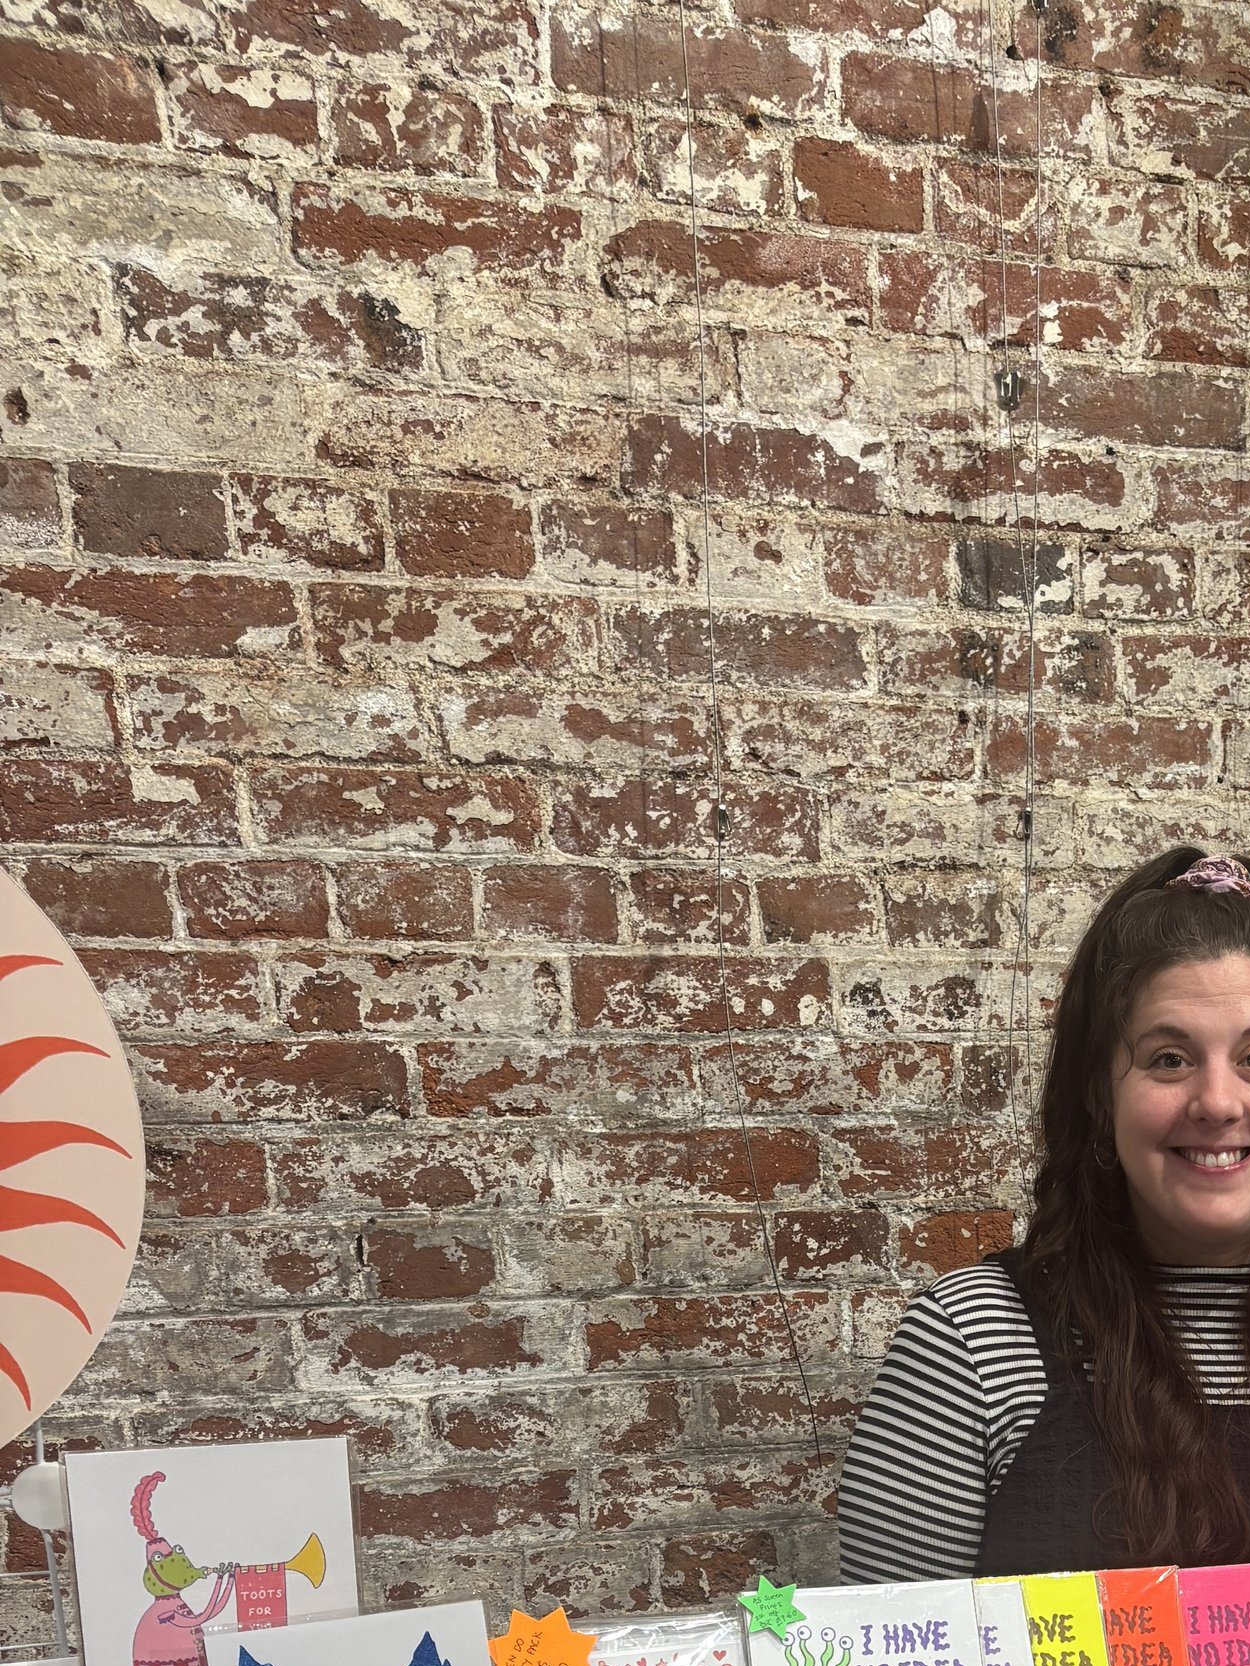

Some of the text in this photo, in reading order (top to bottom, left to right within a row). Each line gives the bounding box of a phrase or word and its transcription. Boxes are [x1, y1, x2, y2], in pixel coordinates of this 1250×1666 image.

[241, 1590, 282, 1600] TOOTS
[249, 1608, 271, 1616] FOR
[527, 1632, 542, 1655] PACK
[861, 1620, 950, 1655] I HAVE
[514, 1638, 524, 1652] DO
